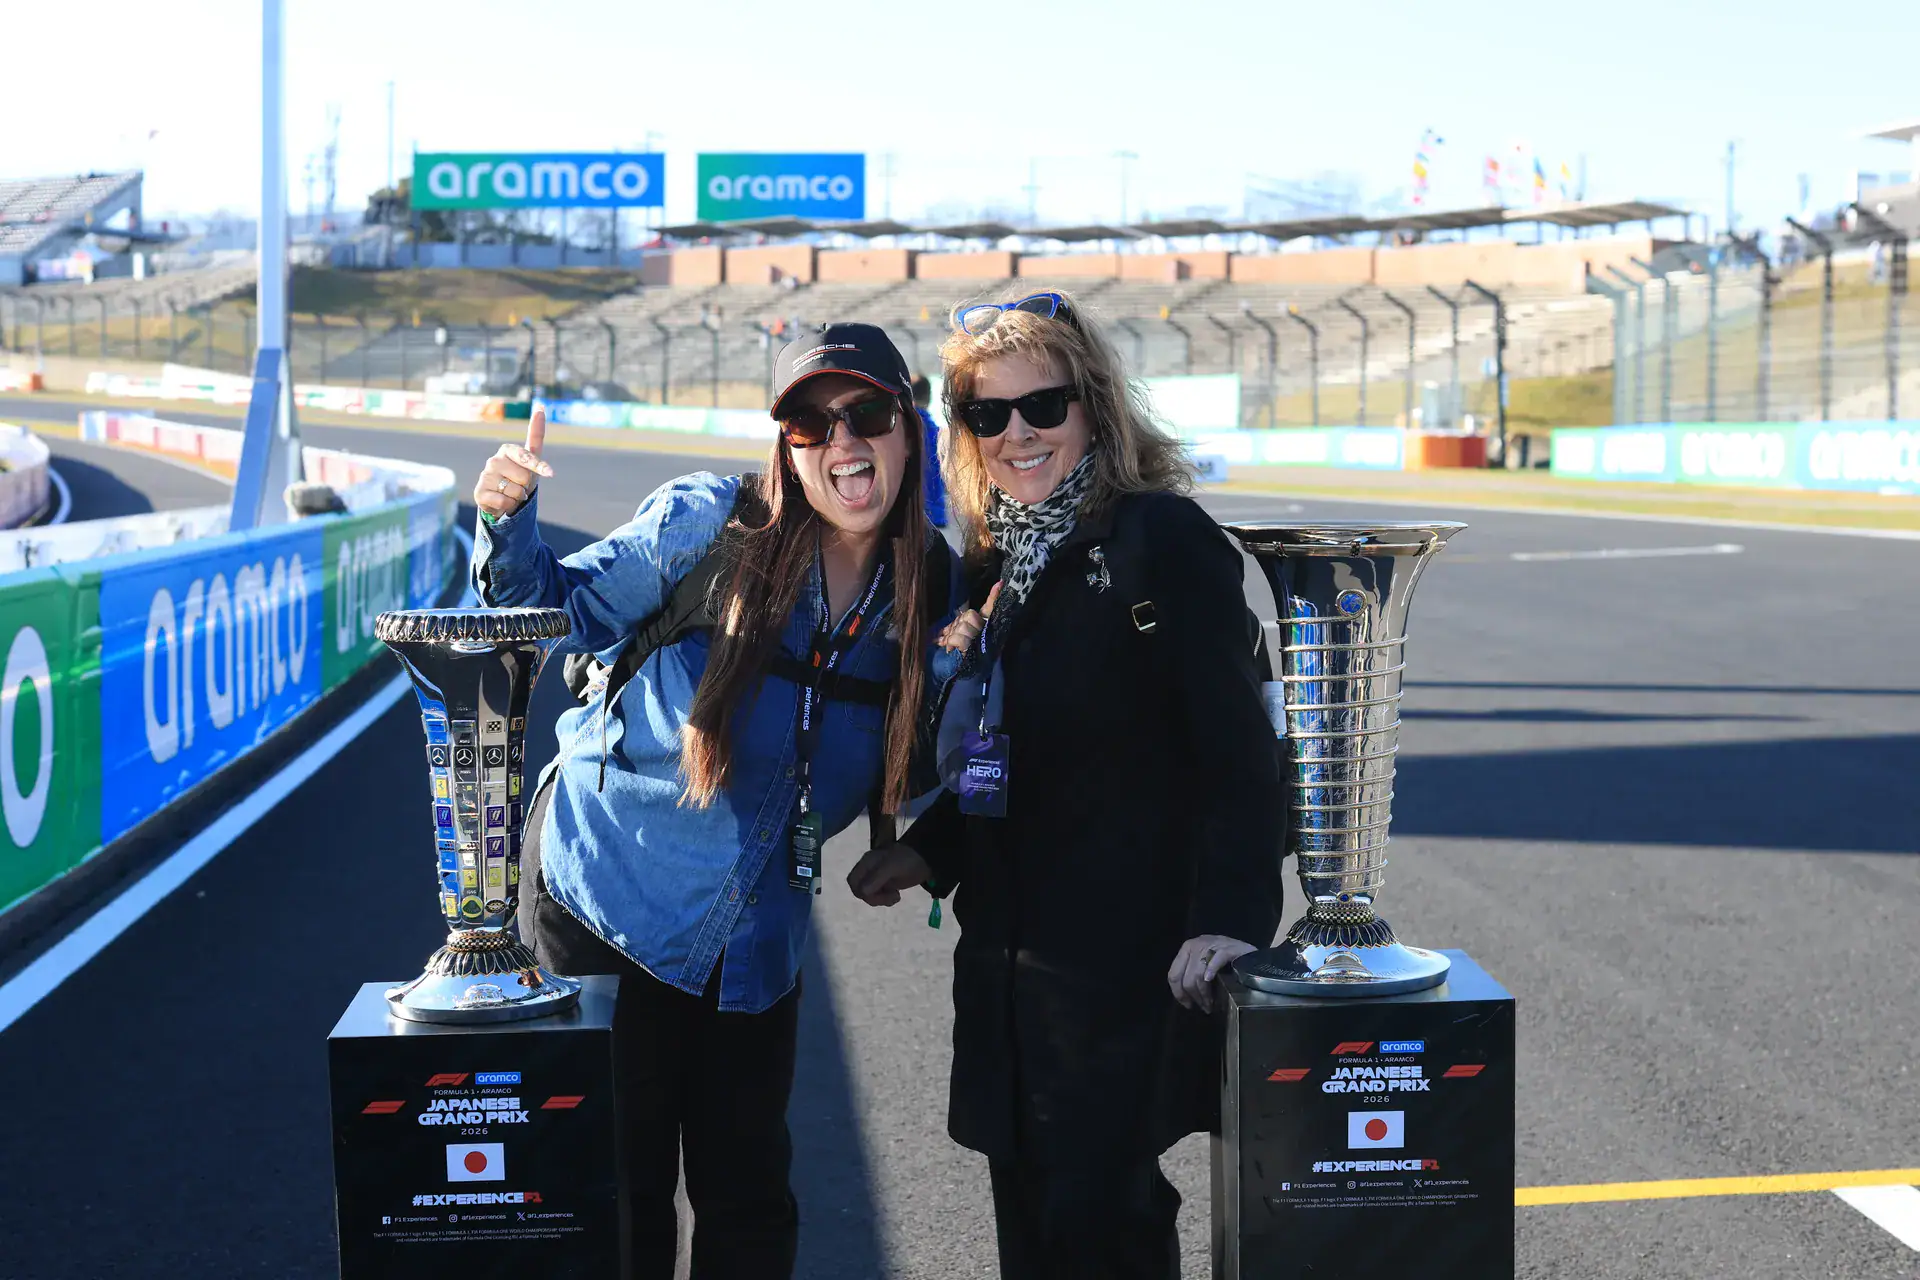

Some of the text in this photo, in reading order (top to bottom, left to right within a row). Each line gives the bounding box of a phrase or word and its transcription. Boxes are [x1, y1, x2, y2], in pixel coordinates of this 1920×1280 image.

[428, 162, 649, 199] aramco
[708, 174, 853, 201] aramco
[859, 563, 885, 615] Experiences
[144, 552, 308, 764] aramco
[803, 686, 812, 731] periences
[966, 764, 1002, 779] HERO
[478, 1074, 518, 1083] aramco
[1331, 1066, 1422, 1080] JAPANESE
[1322, 1079, 1430, 1093] GRAND PRIX
[426, 1097, 520, 1112] JAPANESE
[418, 1110, 530, 1126] GRAND PRIX
[460, 1128, 488, 1136] 2026
[1312, 1159, 1439, 1172] #EXPERIENCEF1
[412, 1192, 542, 1206] #EXPERIENCEF1
